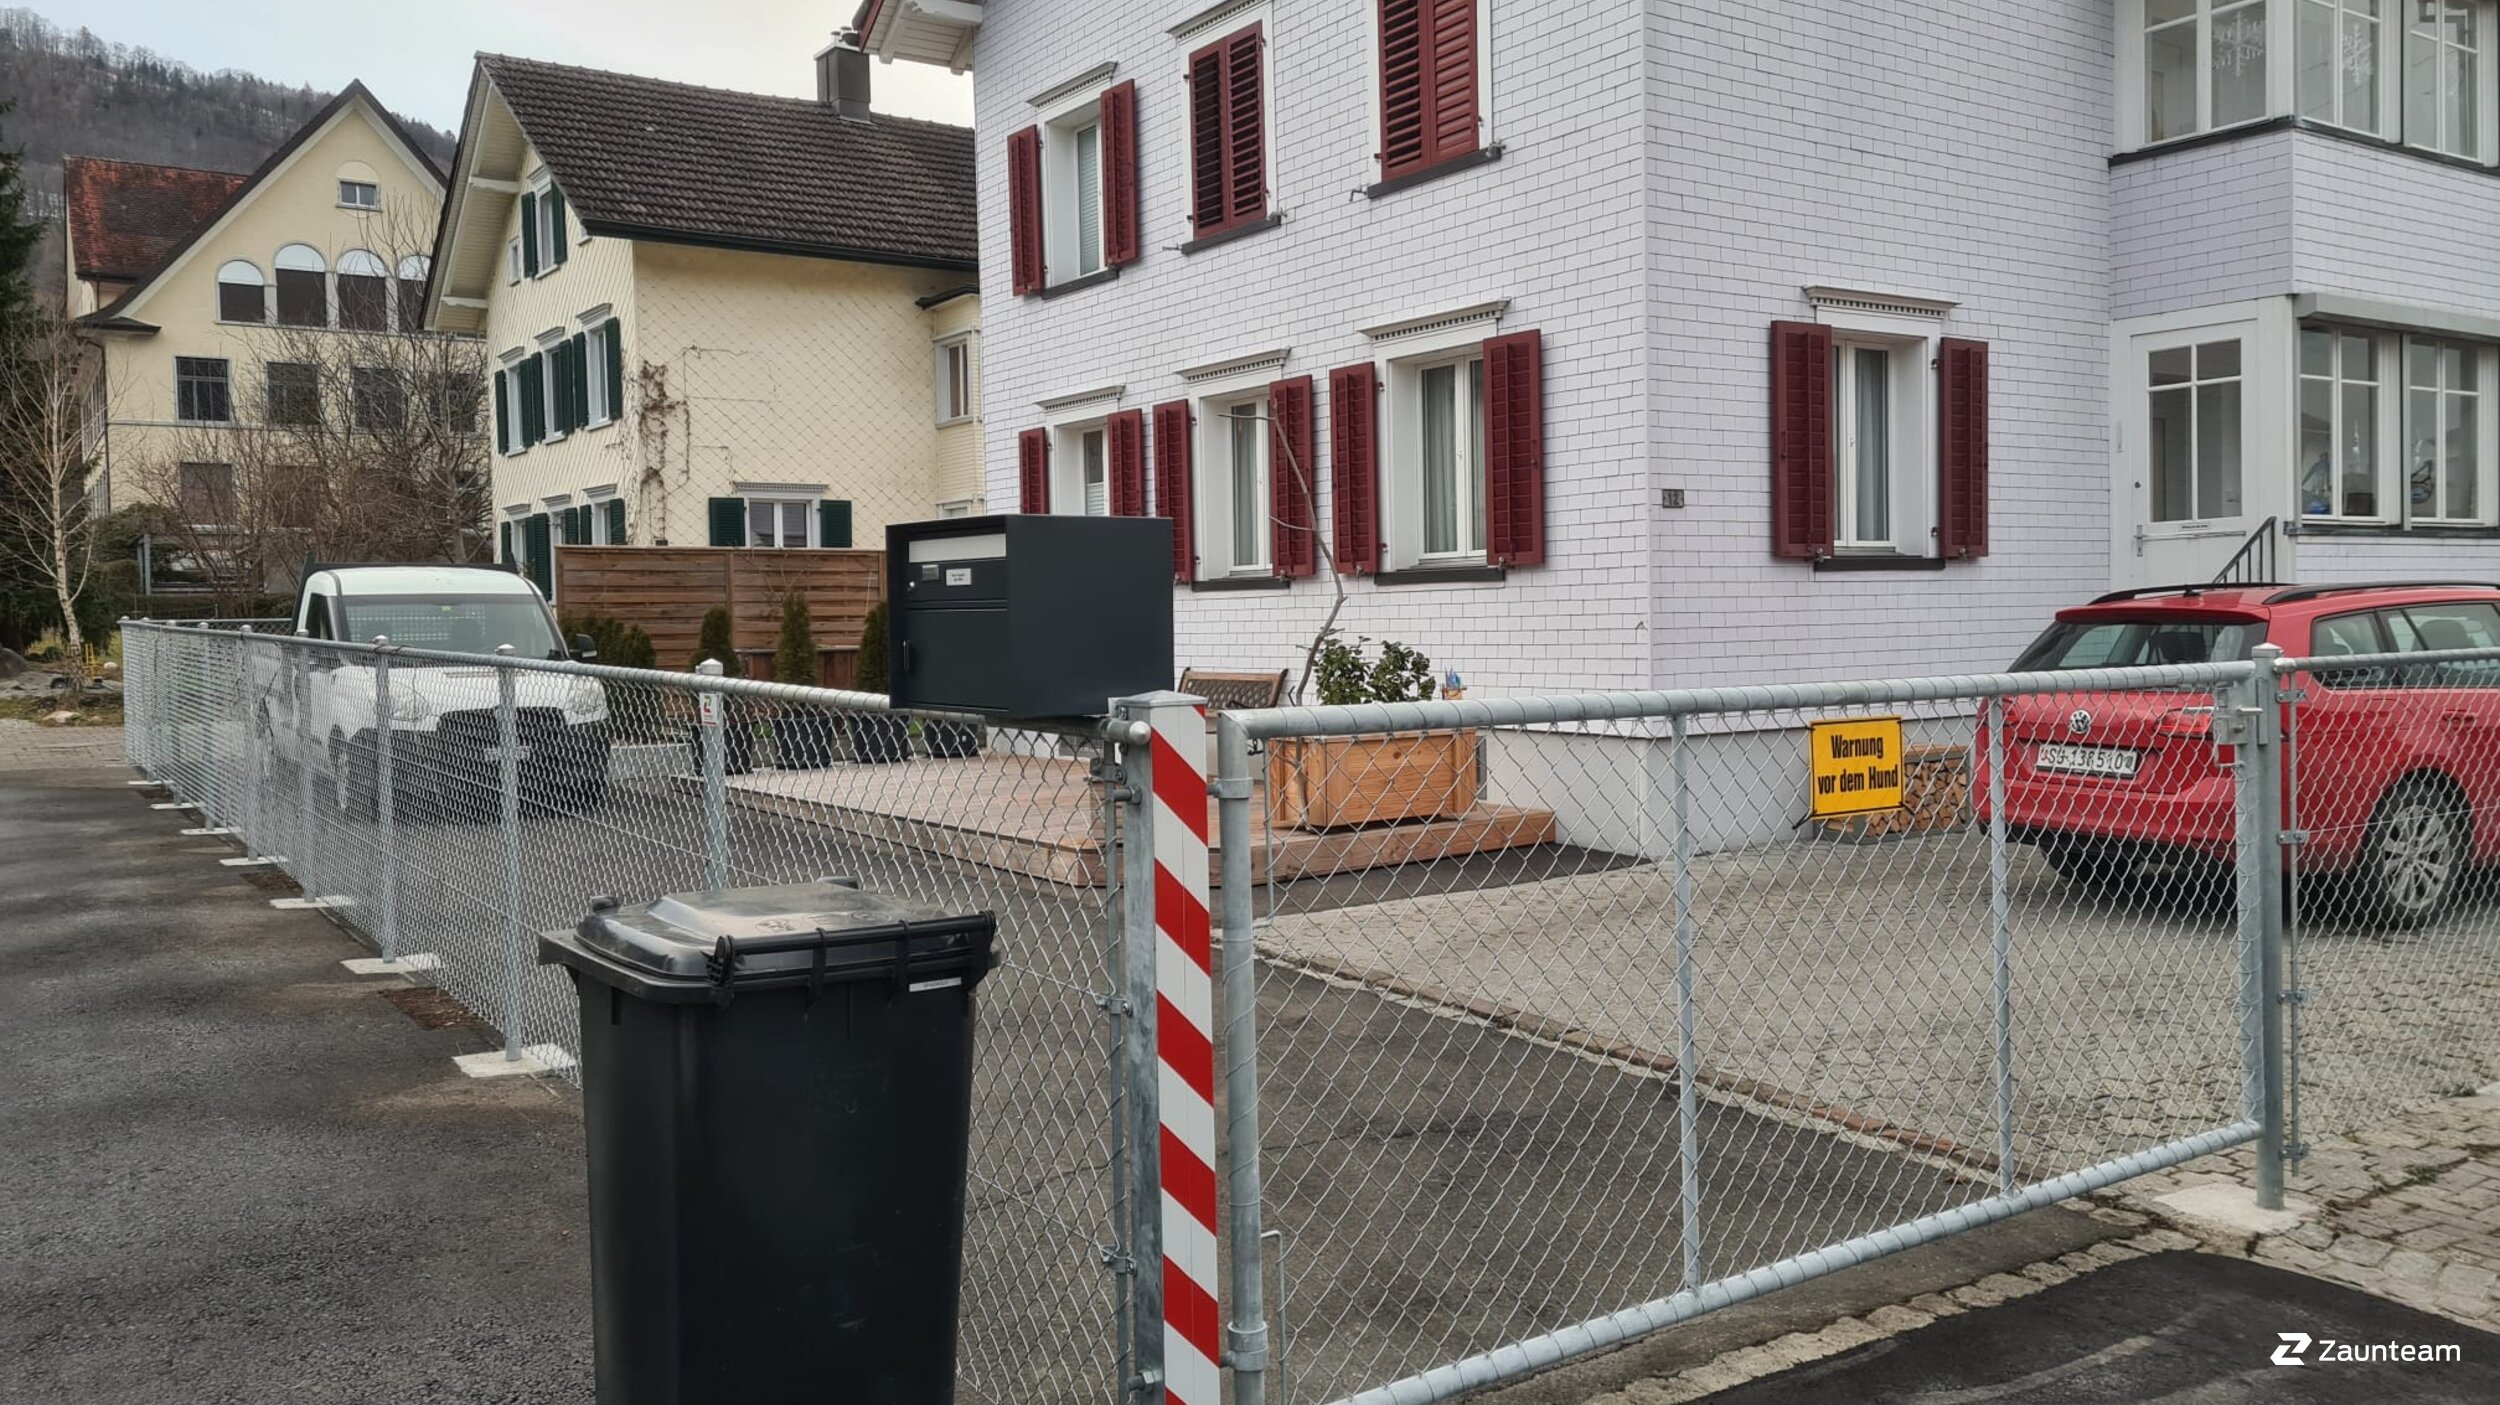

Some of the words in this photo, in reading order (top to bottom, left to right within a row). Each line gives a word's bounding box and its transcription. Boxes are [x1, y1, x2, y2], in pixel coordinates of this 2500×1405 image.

[1831, 735, 1883, 759] Warnung
[1818, 775, 1836, 795] vor
[1840, 768, 1864, 792] dem
[1868, 764, 1898, 790] Hund
